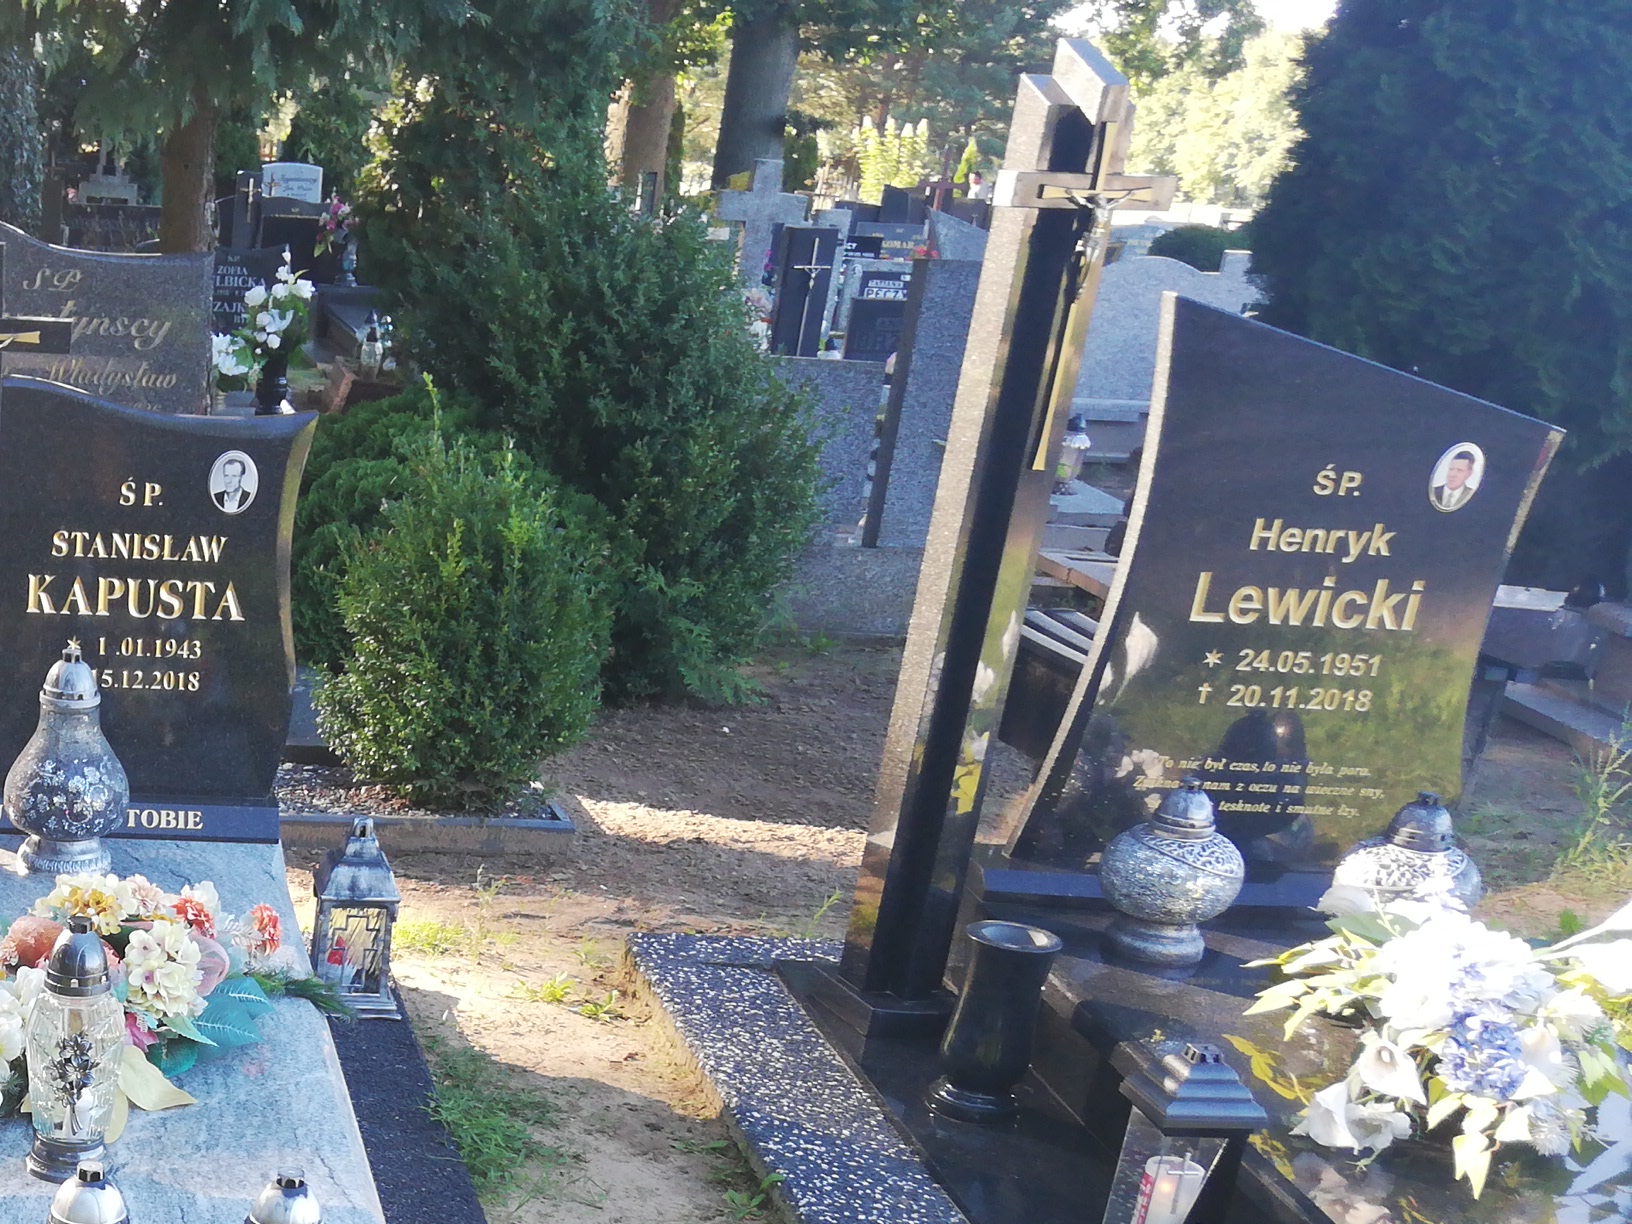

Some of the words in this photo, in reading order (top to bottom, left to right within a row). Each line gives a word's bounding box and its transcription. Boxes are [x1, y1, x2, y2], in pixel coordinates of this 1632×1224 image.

[51, 530, 229, 563] STANISŁAW
[1249, 517, 1397, 564] Henryk
[26, 574, 246, 621] KAPUSTA
[1189, 571, 1426, 632] Lewicki
[1235, 649, 1383, 677] 24.05.1951
[1226, 684, 1374, 712] 20.11.2018
[1202, 781, 1231, 791] nam
[1248, 783, 1278, 793] oczu
[1282, 784, 1300, 793] na
[126, 808, 204, 829] TOBIE
